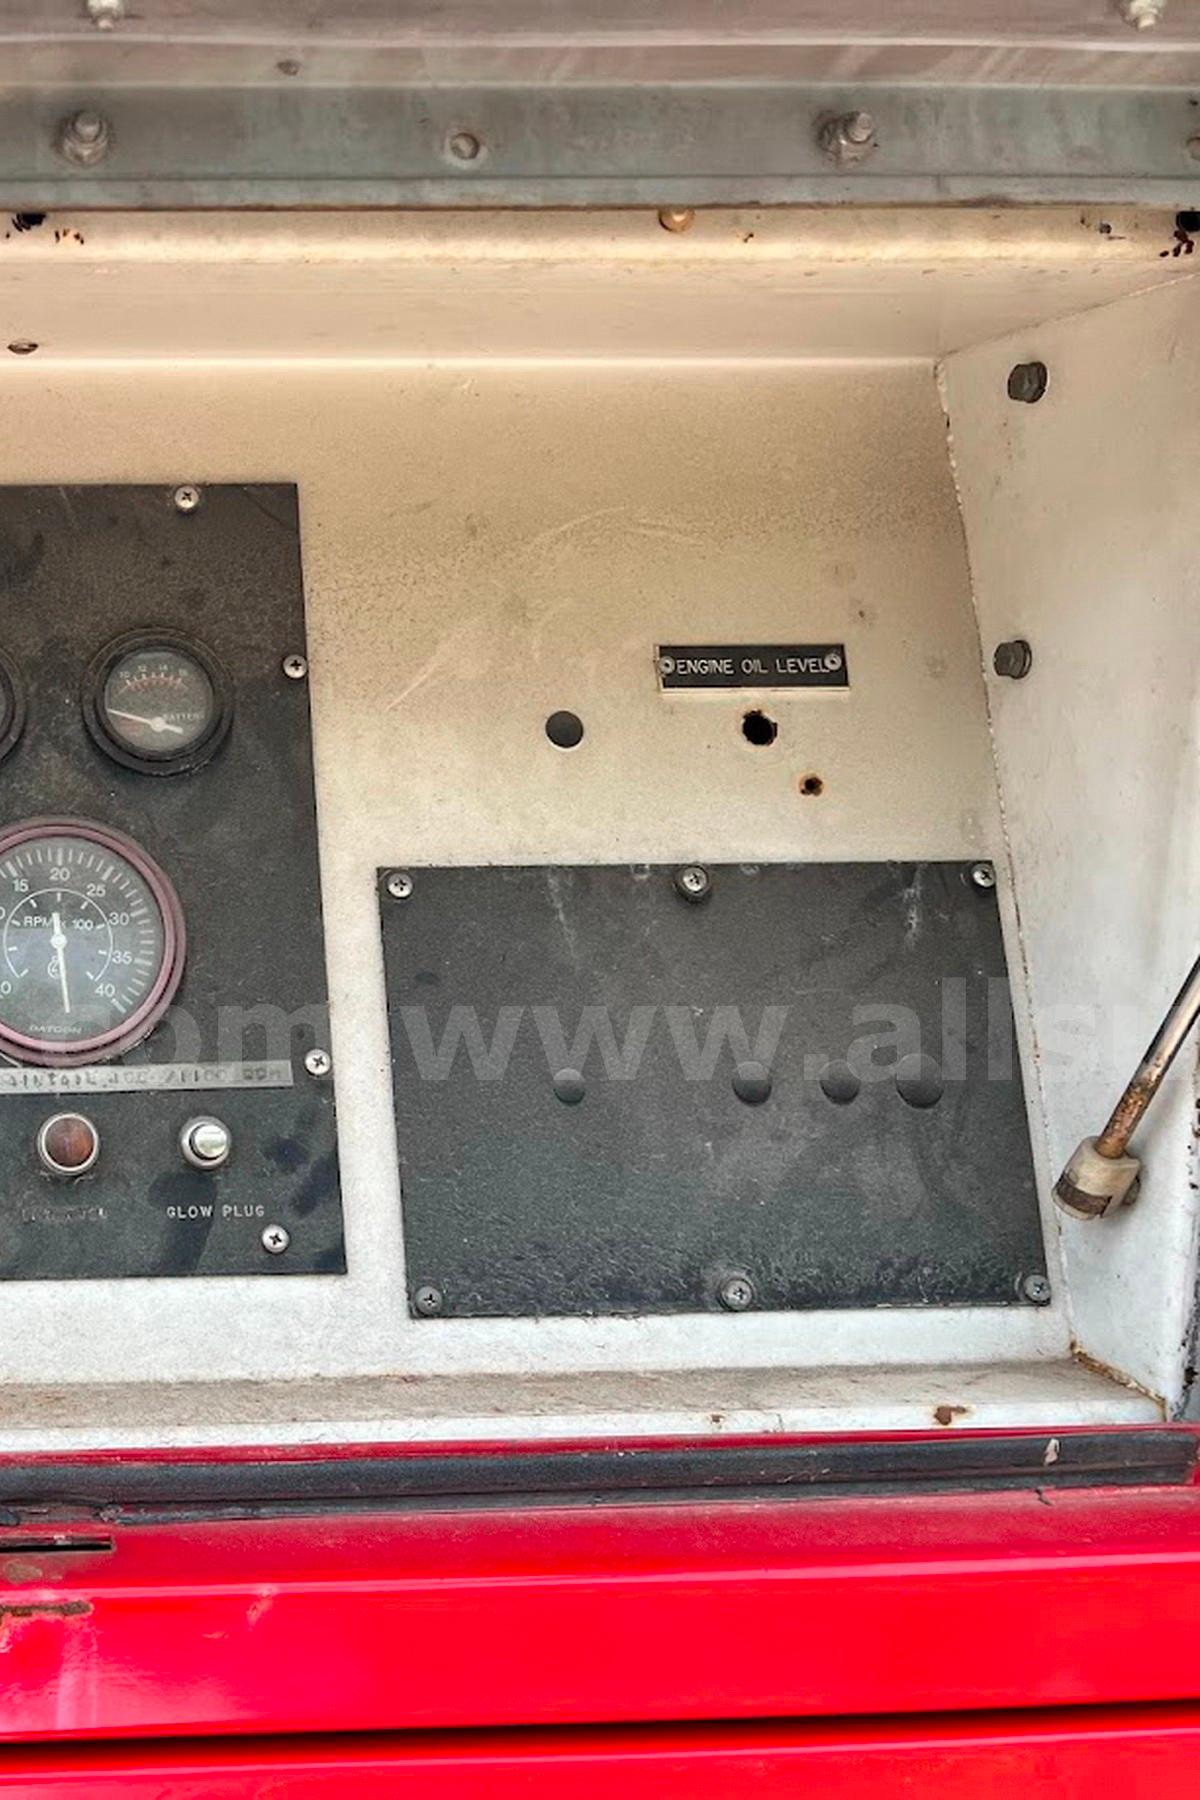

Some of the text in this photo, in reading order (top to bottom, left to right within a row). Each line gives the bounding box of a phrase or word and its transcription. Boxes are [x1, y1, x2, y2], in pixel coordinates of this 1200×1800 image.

[676, 658, 830, 675] ENGINE OIL LEVEL
[50, 867, 71, 881] 20
[13, 879, 29, 892] 15
[87, 883, 106, 897] 25
[72, 918, 94, 930] 100
[109, 912, 129, 925] 30
[112, 951, 132, 965] 35
[0, 981, 12, 994] 0
[95, 984, 116, 998] 40
[166, 1204, 265, 1219] GLOW PLUG
